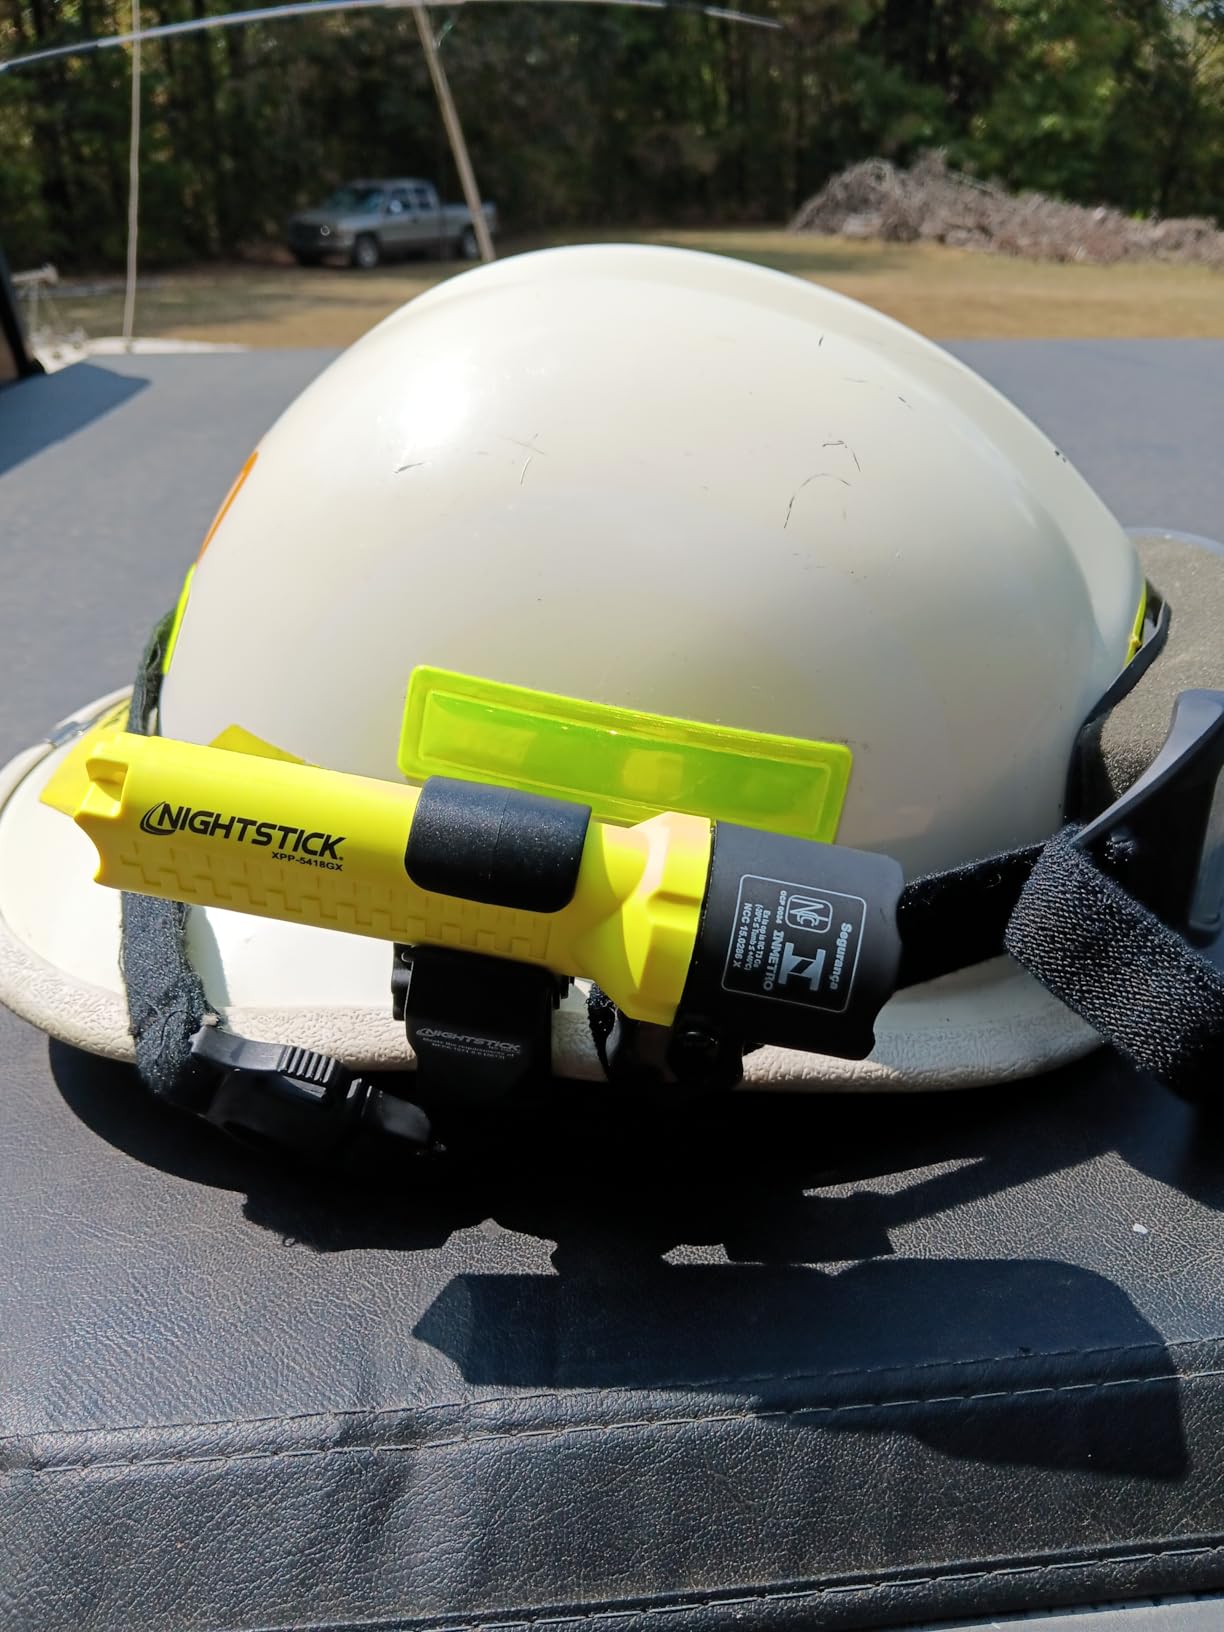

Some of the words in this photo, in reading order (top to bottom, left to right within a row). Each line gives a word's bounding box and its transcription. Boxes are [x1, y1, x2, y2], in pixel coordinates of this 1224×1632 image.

[153, 802, 347, 860] NIGHTSTICK
[271, 851, 343, 872] XPP-5418GX
[741, 902, 753, 924] NCC
[732, 959, 742, 968] X
[762, 929, 785, 991] INMETRO
[416, 1028, 520, 1050] NIGHTSTICK
